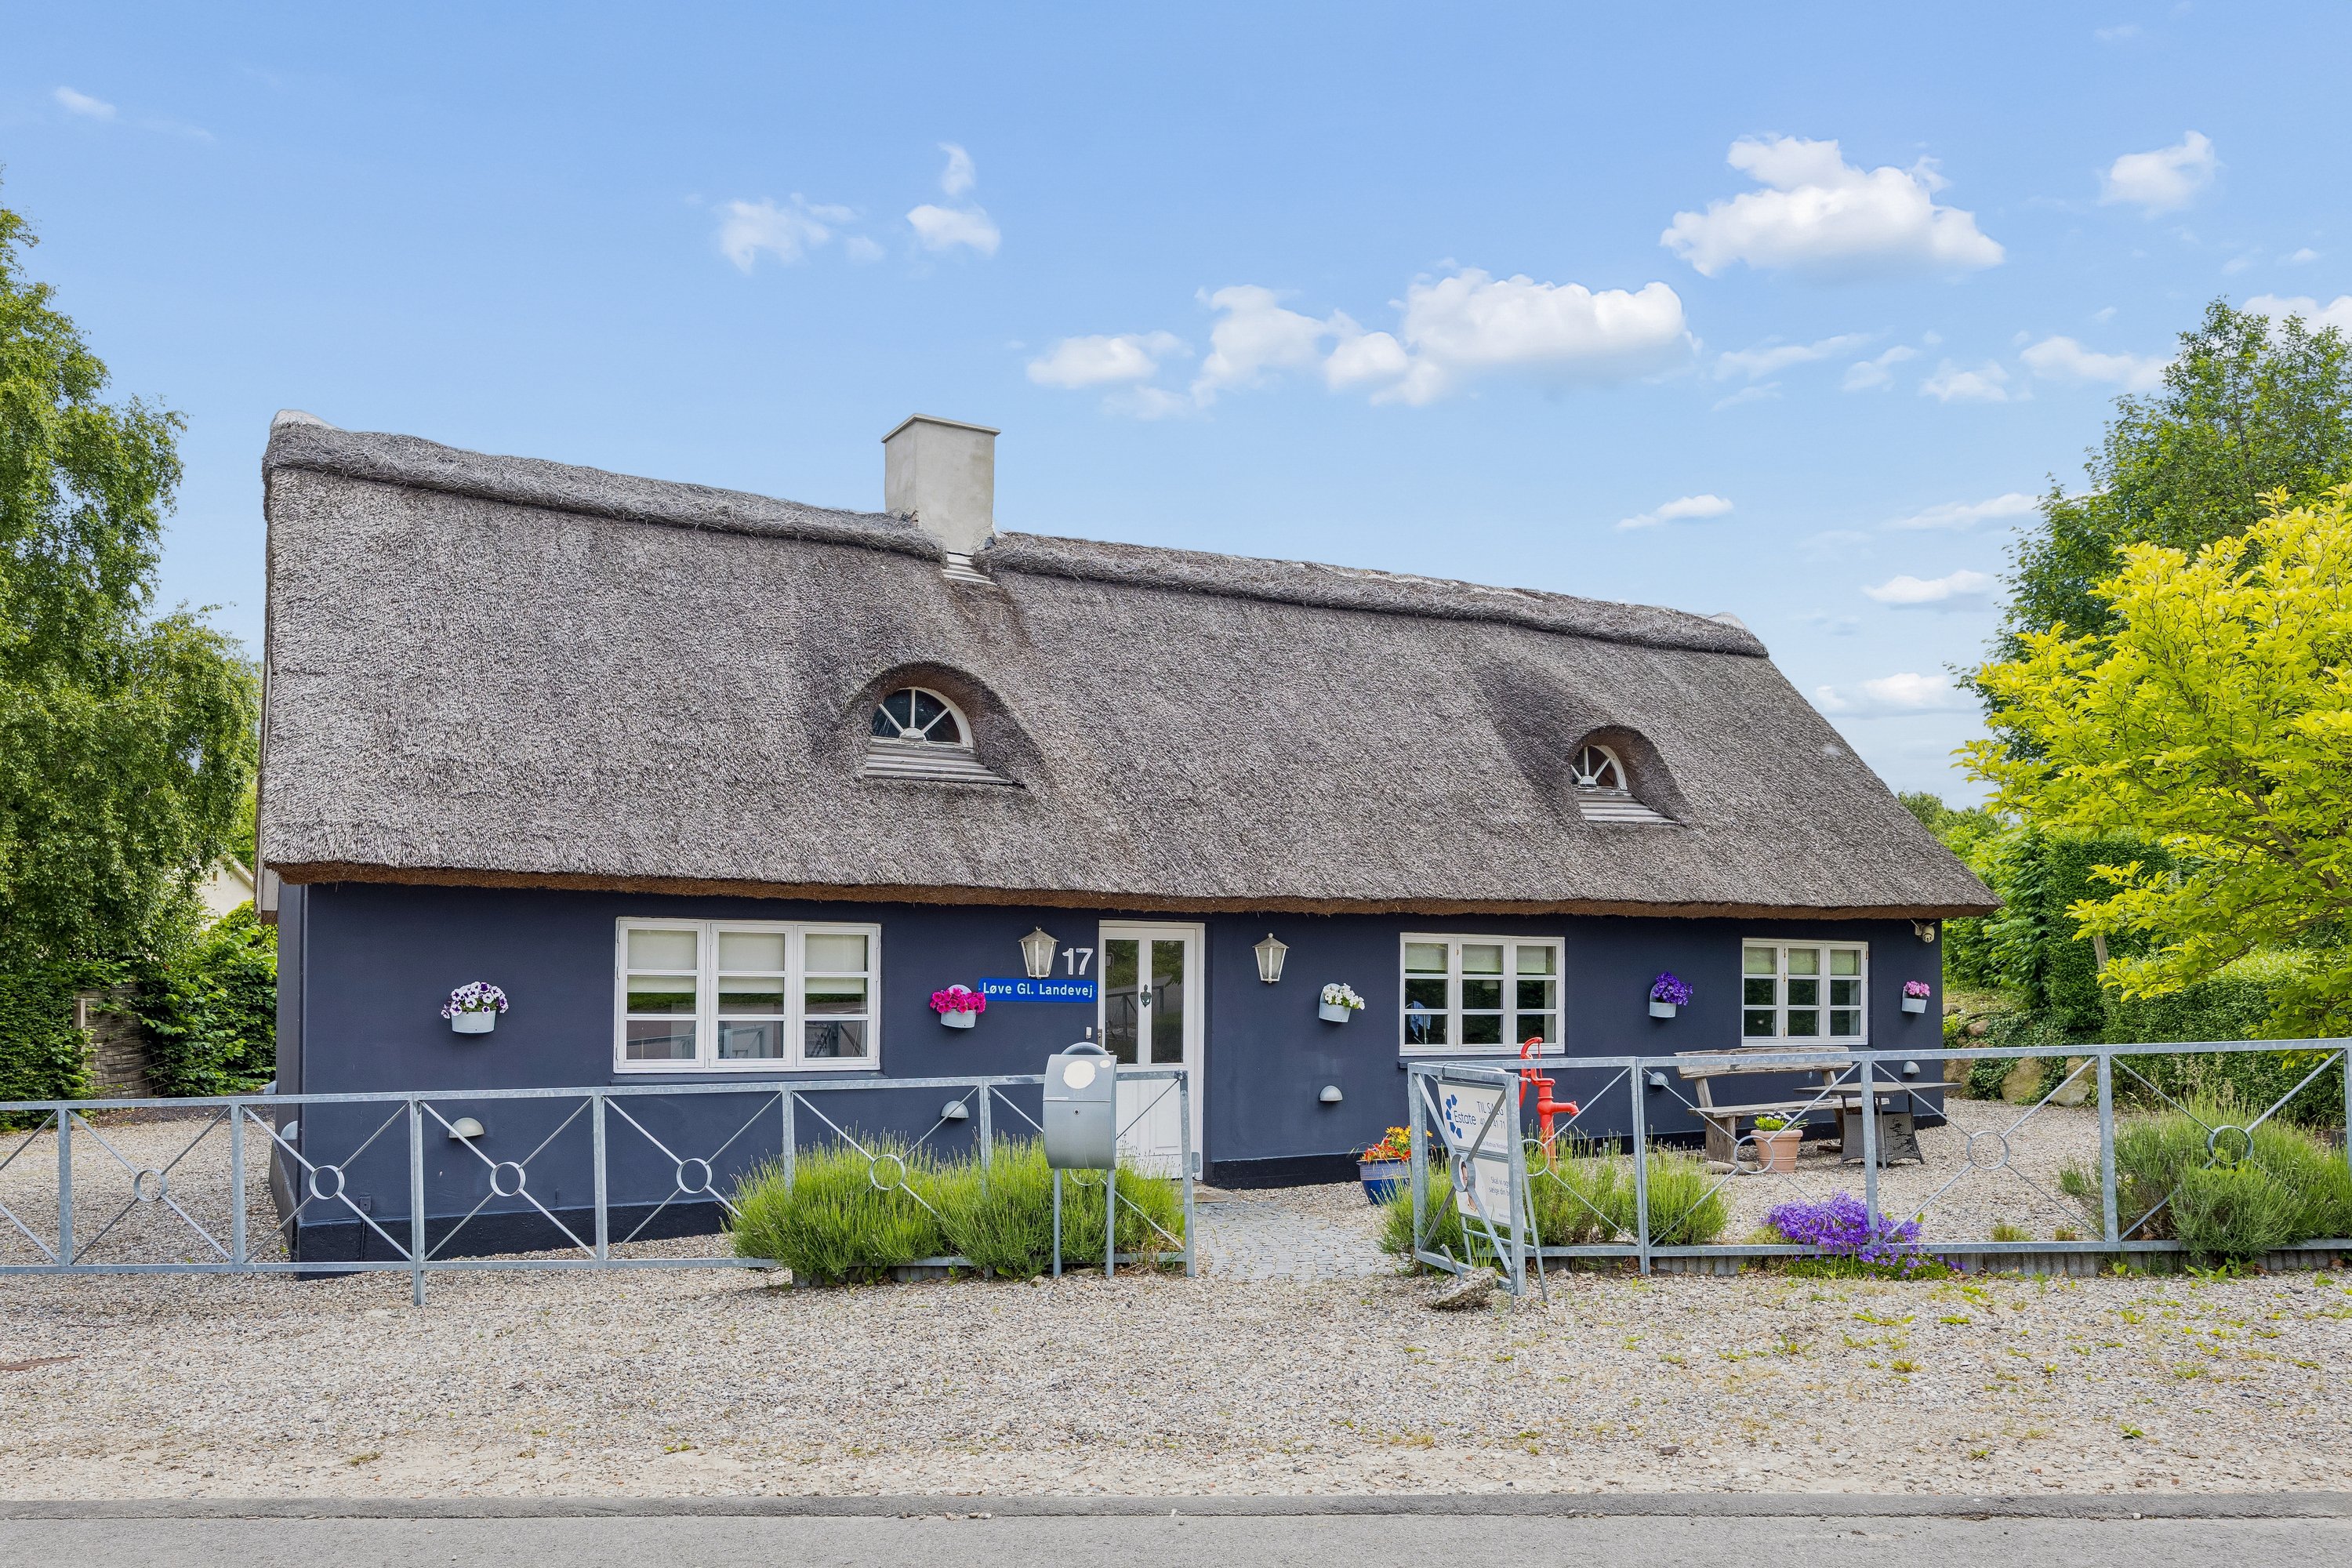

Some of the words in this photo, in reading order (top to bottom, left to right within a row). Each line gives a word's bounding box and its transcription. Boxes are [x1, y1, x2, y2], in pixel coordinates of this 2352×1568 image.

[1062, 947, 1094, 975] 17
[983, 982, 1012, 994] Løve
[1017, 982, 1034, 995] Gl.
[1039, 983, 1093, 998] Landevej
[1476, 1101, 1486, 1114] TIL
[1487, 1102, 1504, 1116] SAG
[1454, 1110, 1476, 1125] Estate
